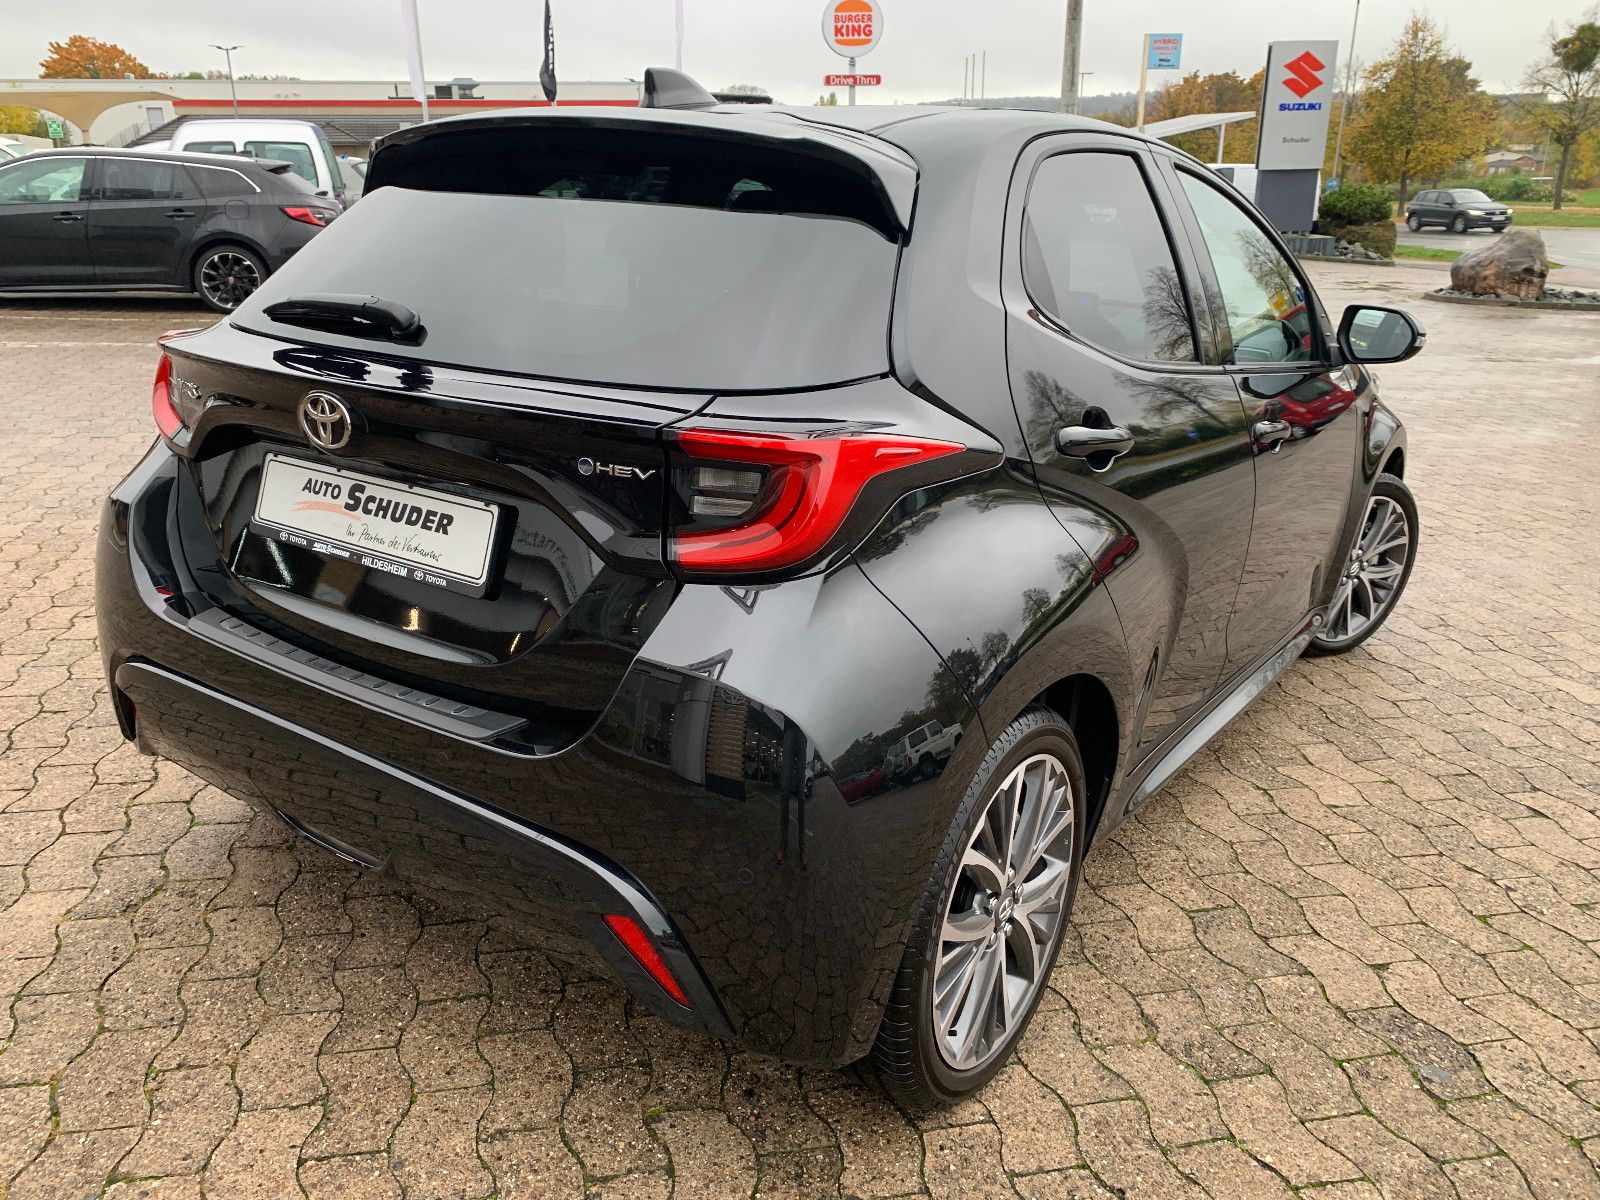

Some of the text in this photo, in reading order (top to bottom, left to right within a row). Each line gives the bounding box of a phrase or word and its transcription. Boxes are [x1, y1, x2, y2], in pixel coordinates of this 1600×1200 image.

[834, 14, 873, 23] BURGER
[834, 24, 873, 37] KING
[830, 76, 877, 85] Drive Thru
[1279, 103, 1322, 111] SUZUKI
[1282, 136, 1311, 144] Schuder
[595, 461, 656, 480] HEV
[301, 477, 454, 535] AUTO SCHUDER
[358, 523, 386, 542] Partner
[388, 535, 401, 550] des
[401, 534, 443, 562] Vertrauens
[289, 535, 447, 587] TOYOTA AUTO SCHUDER HILDESHEIM TOYOTA
